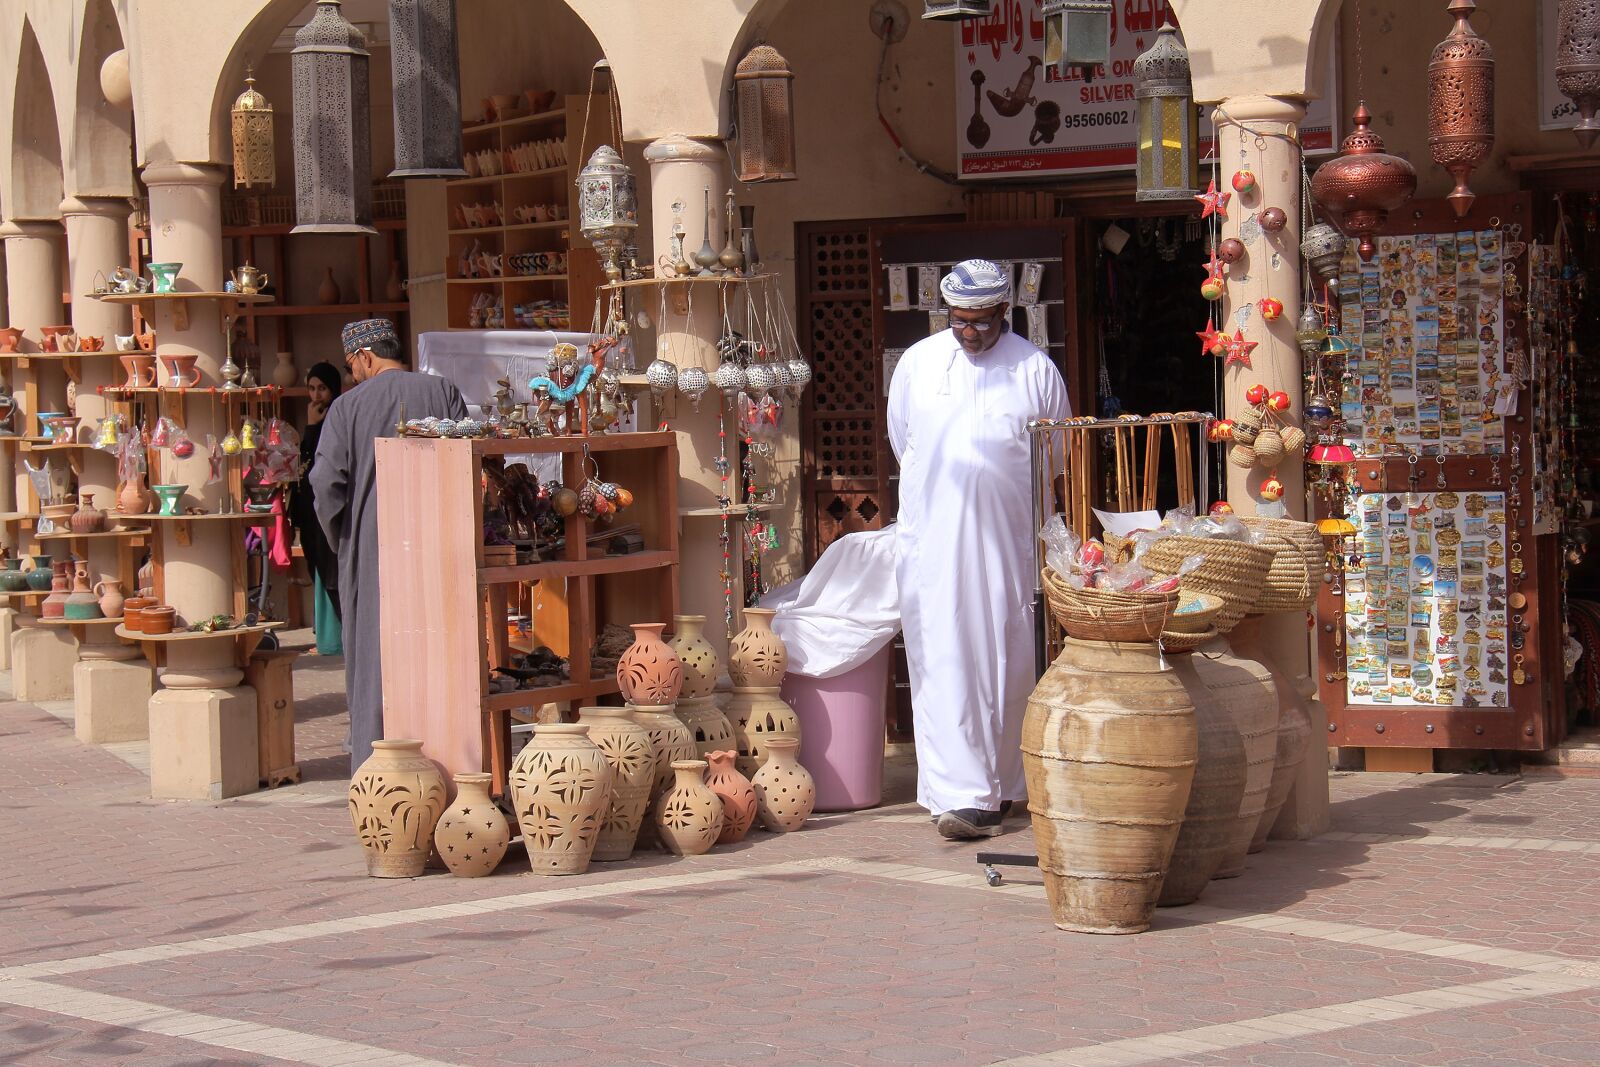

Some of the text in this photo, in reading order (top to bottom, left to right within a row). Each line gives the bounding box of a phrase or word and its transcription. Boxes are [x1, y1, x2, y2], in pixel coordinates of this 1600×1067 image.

[1112, 59, 1135, 77] OM
[1080, 82, 1135, 104] SILVER
[1065, 109, 1129, 129] 95560602
